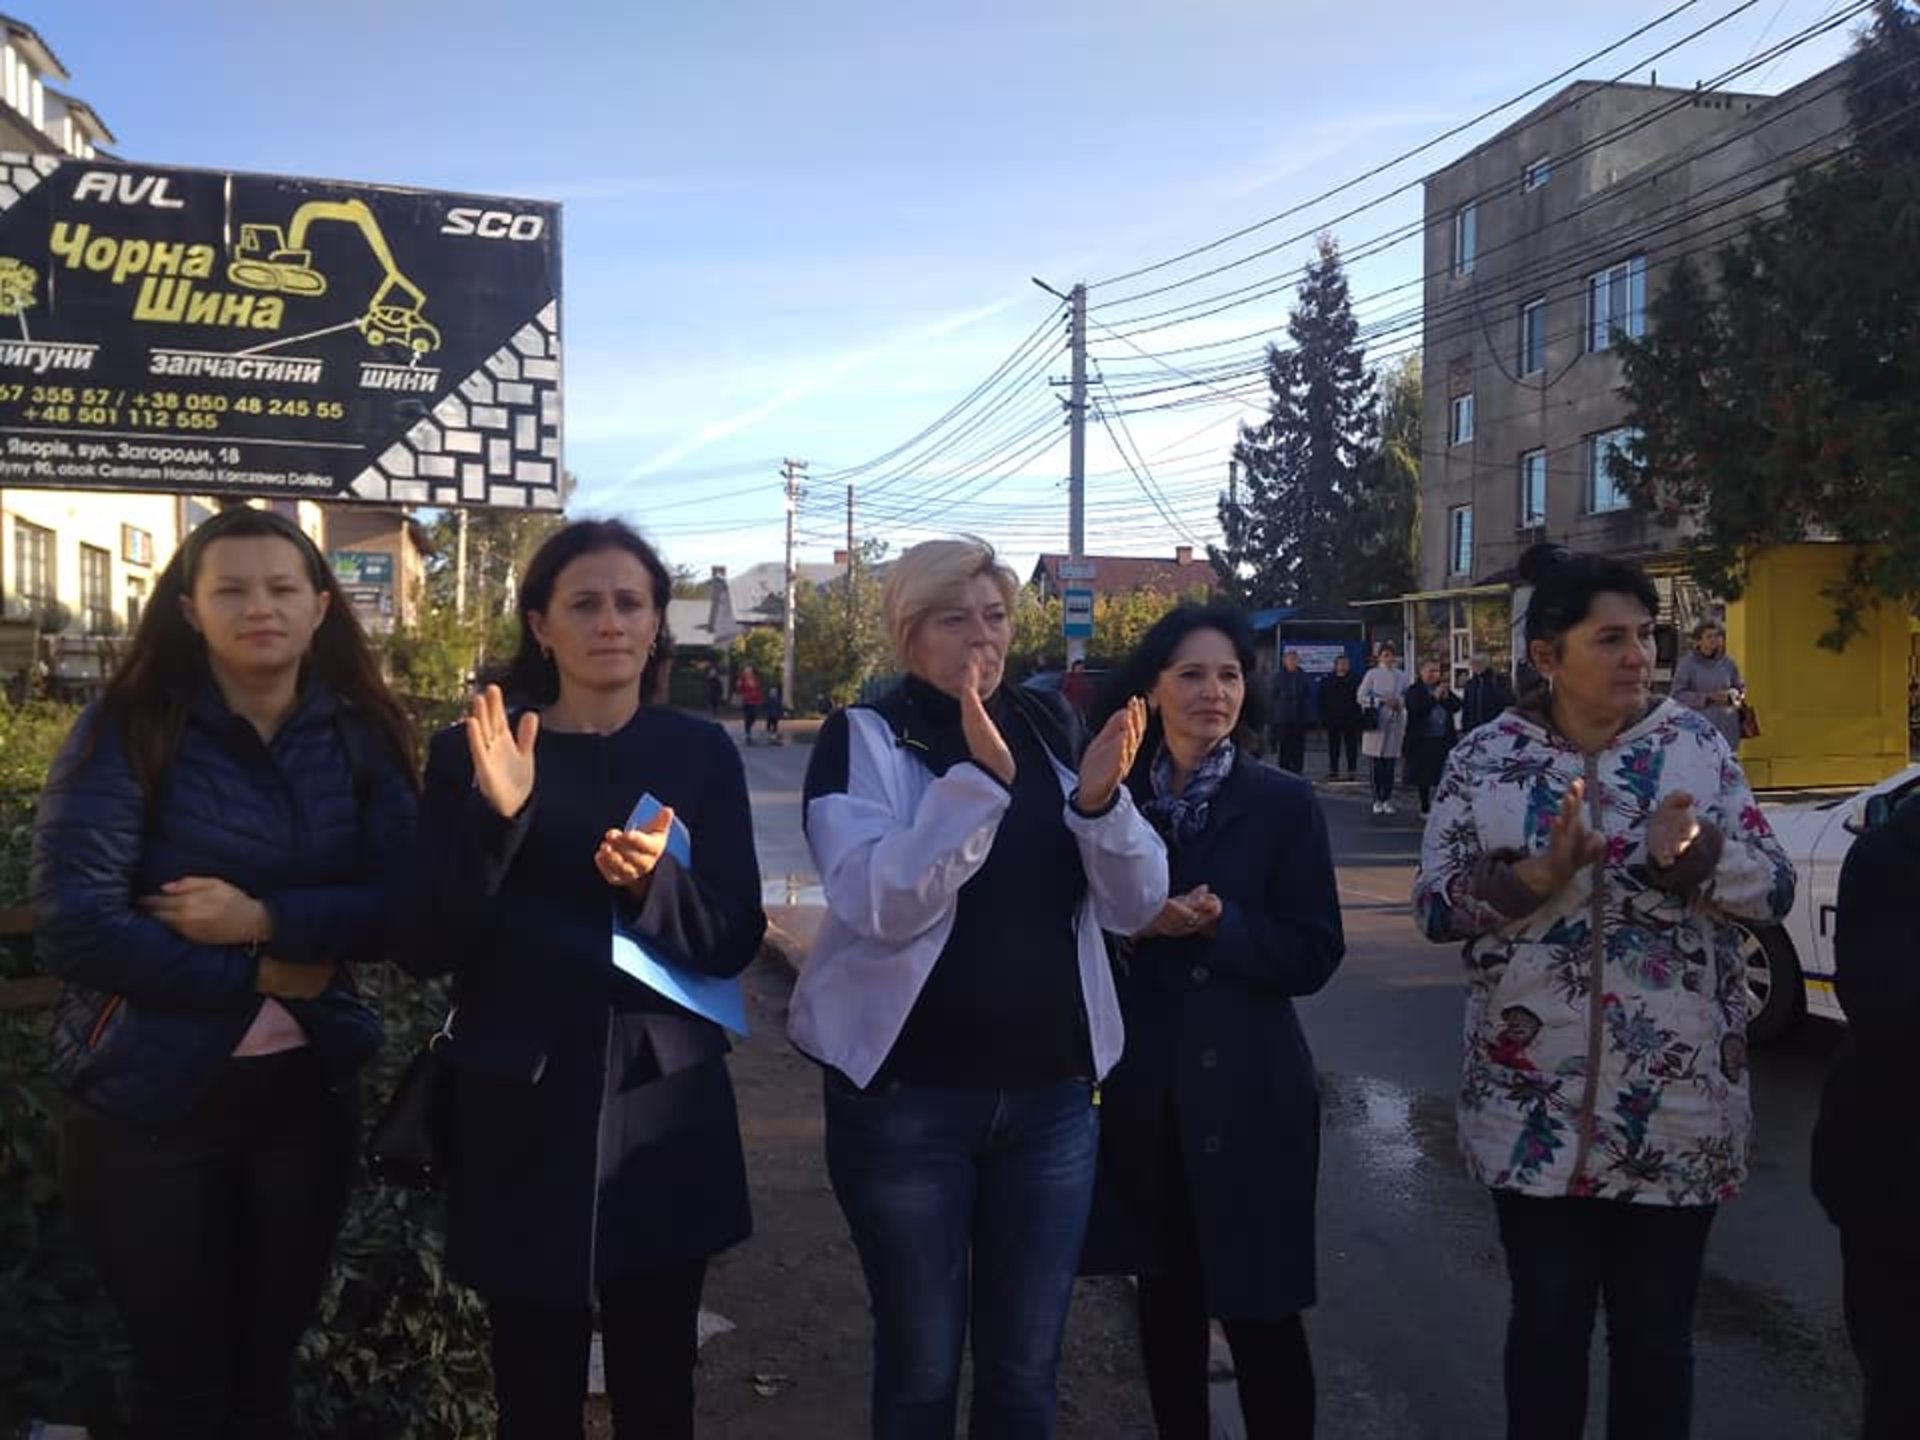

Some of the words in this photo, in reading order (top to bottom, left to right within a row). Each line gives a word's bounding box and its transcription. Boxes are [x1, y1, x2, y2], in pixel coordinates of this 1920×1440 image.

[73, 171, 185, 208] AVL
[441, 207, 544, 240] SCO
[50, 221, 216, 284] Чорна
[132, 277, 285, 329] Шина
[0, 345, 95, 373] игуни
[149, 354, 322, 384] запчастини
[360, 369, 438, 392] шини
[22, 405, 70, 422] +48
[77, 407, 117, 425] 501
[128, 409, 169, 427] 112
[176, 411, 218, 429] 555
[31, 385, 75, 404] 355
[81, 388, 111, 405] 57
[132, 391, 179, 409] +38
[185, 393, 228, 412] 050
[233, 396, 262, 414] 48
[268, 399, 310, 417] 245
[316, 402, 344, 419] 55
